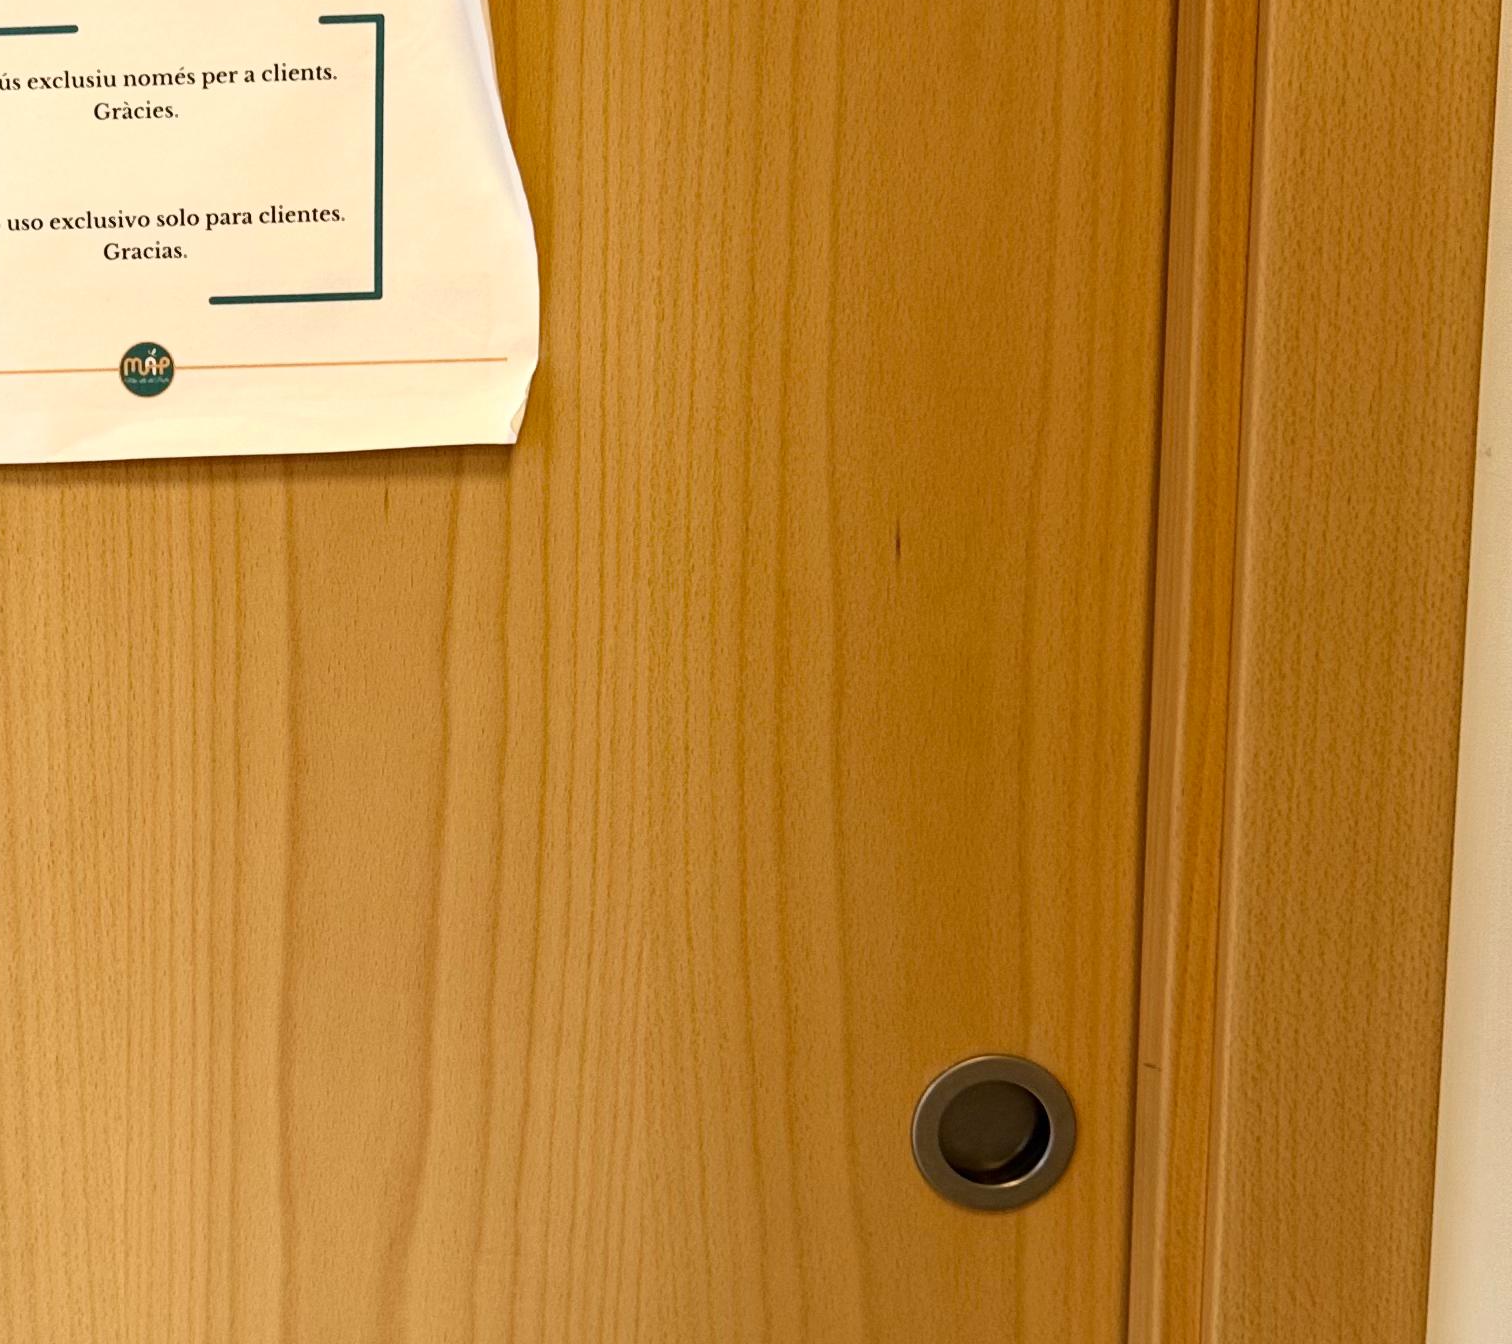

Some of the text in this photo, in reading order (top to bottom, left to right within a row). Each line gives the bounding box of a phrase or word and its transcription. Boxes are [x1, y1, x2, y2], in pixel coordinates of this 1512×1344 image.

[26, 68, 117, 91] exclusiu
[123, 66, 196, 88] només
[201, 70, 239, 90] per
[243, 69, 256, 84] a
[261, 62, 338, 83] clients.
[93, 99, 179, 121] Gràcies.
[7, 217, 44, 232] uso
[49, 209, 151, 231] exclusivo
[156, 207, 200, 228] solo
[205, 211, 253, 232] para
[258, 204, 346, 225] clientes.
[103, 240, 188, 261] Gracias.
